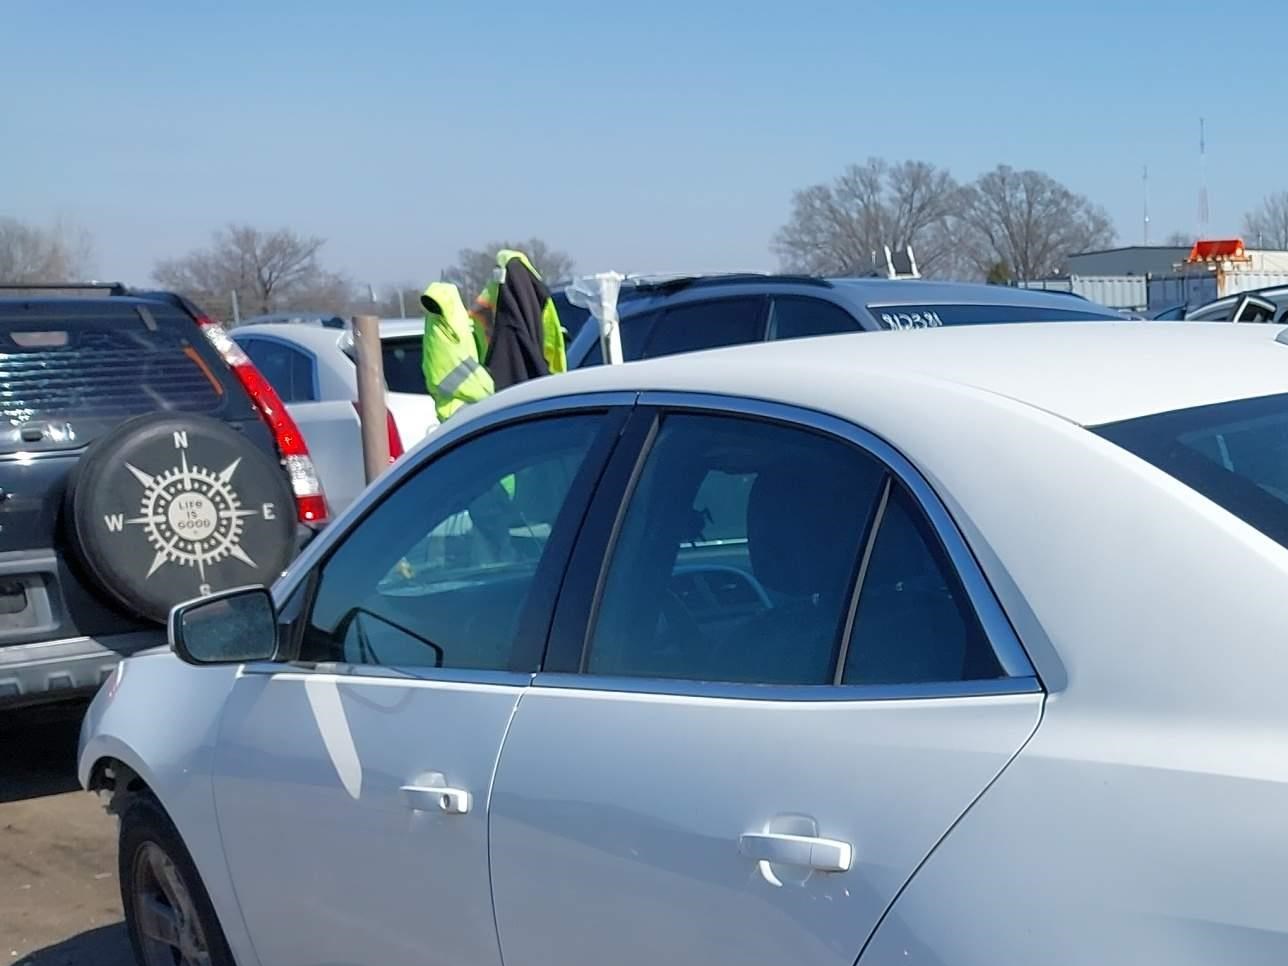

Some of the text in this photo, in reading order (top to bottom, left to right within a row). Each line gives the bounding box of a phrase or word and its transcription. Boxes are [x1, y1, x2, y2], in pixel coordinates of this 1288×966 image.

[173, 431, 189, 449] N
[262, 503, 276, 520] E
[104, 513, 124, 532] W
